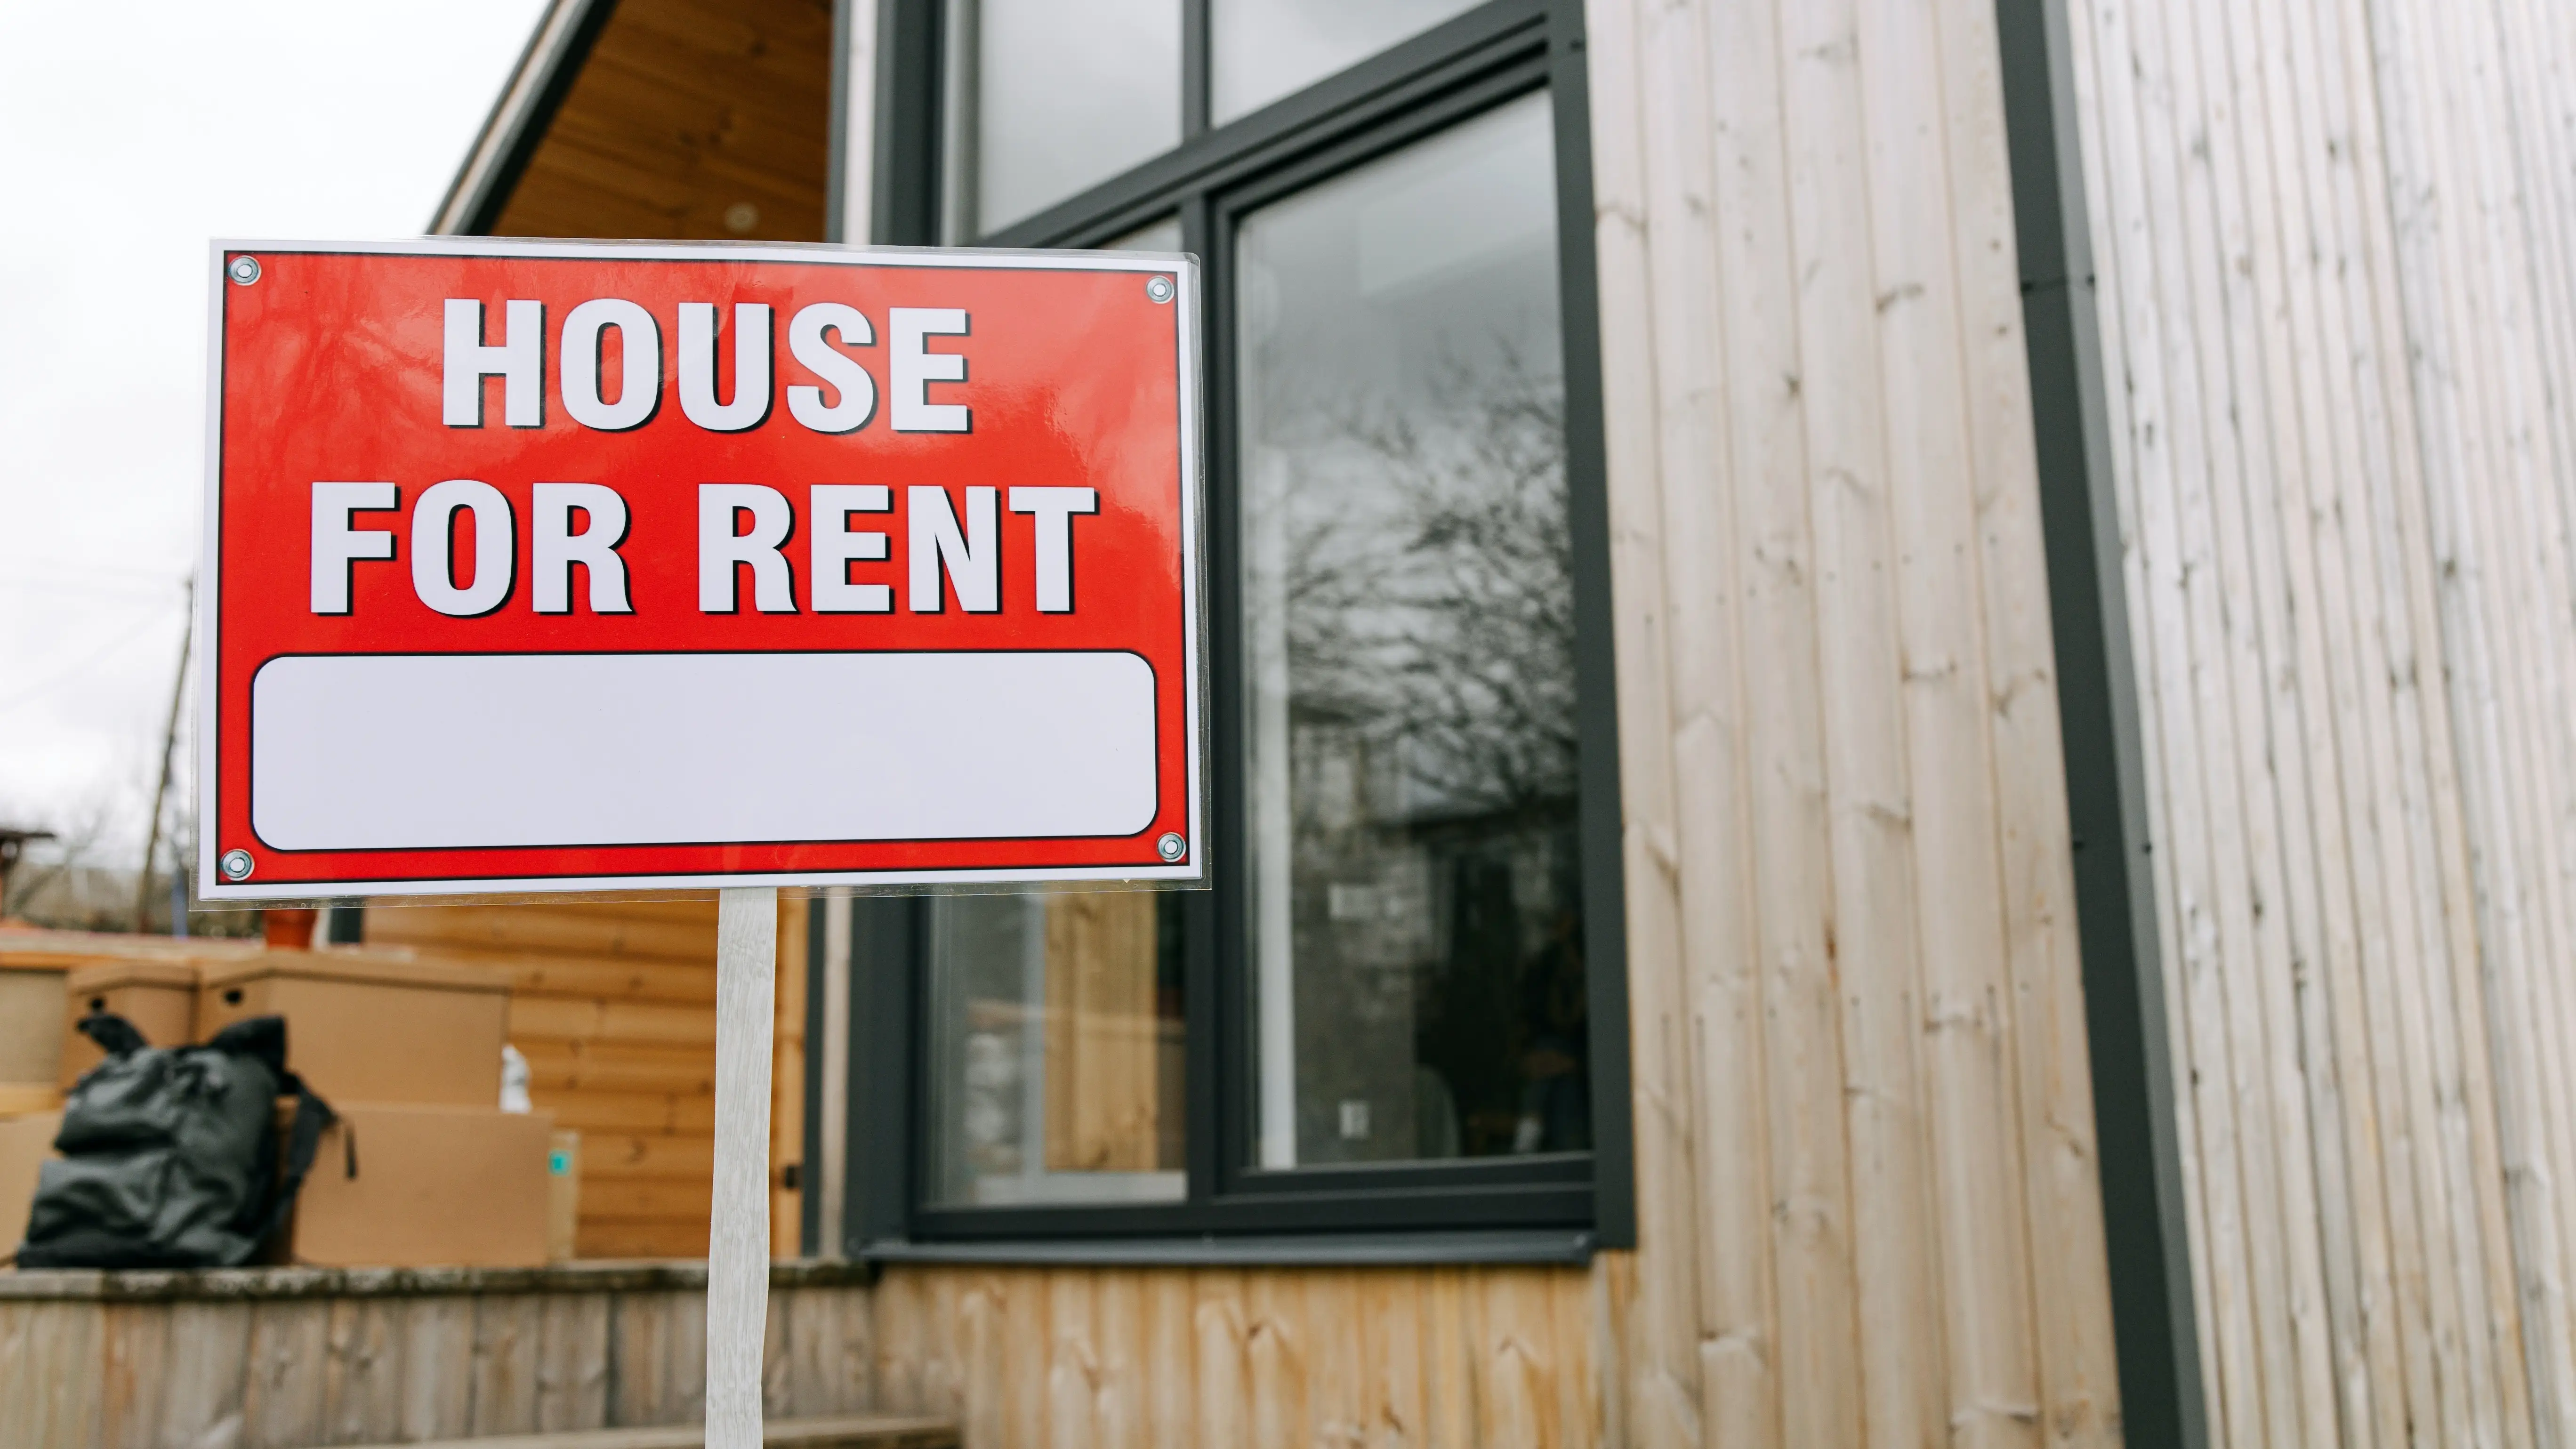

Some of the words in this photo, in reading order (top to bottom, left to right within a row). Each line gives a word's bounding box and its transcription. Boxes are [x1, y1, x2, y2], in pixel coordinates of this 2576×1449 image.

[443, 298, 972, 433] HOUSE
[310, 479, 633, 616] FOR
[698, 483, 1098, 615] RENT
